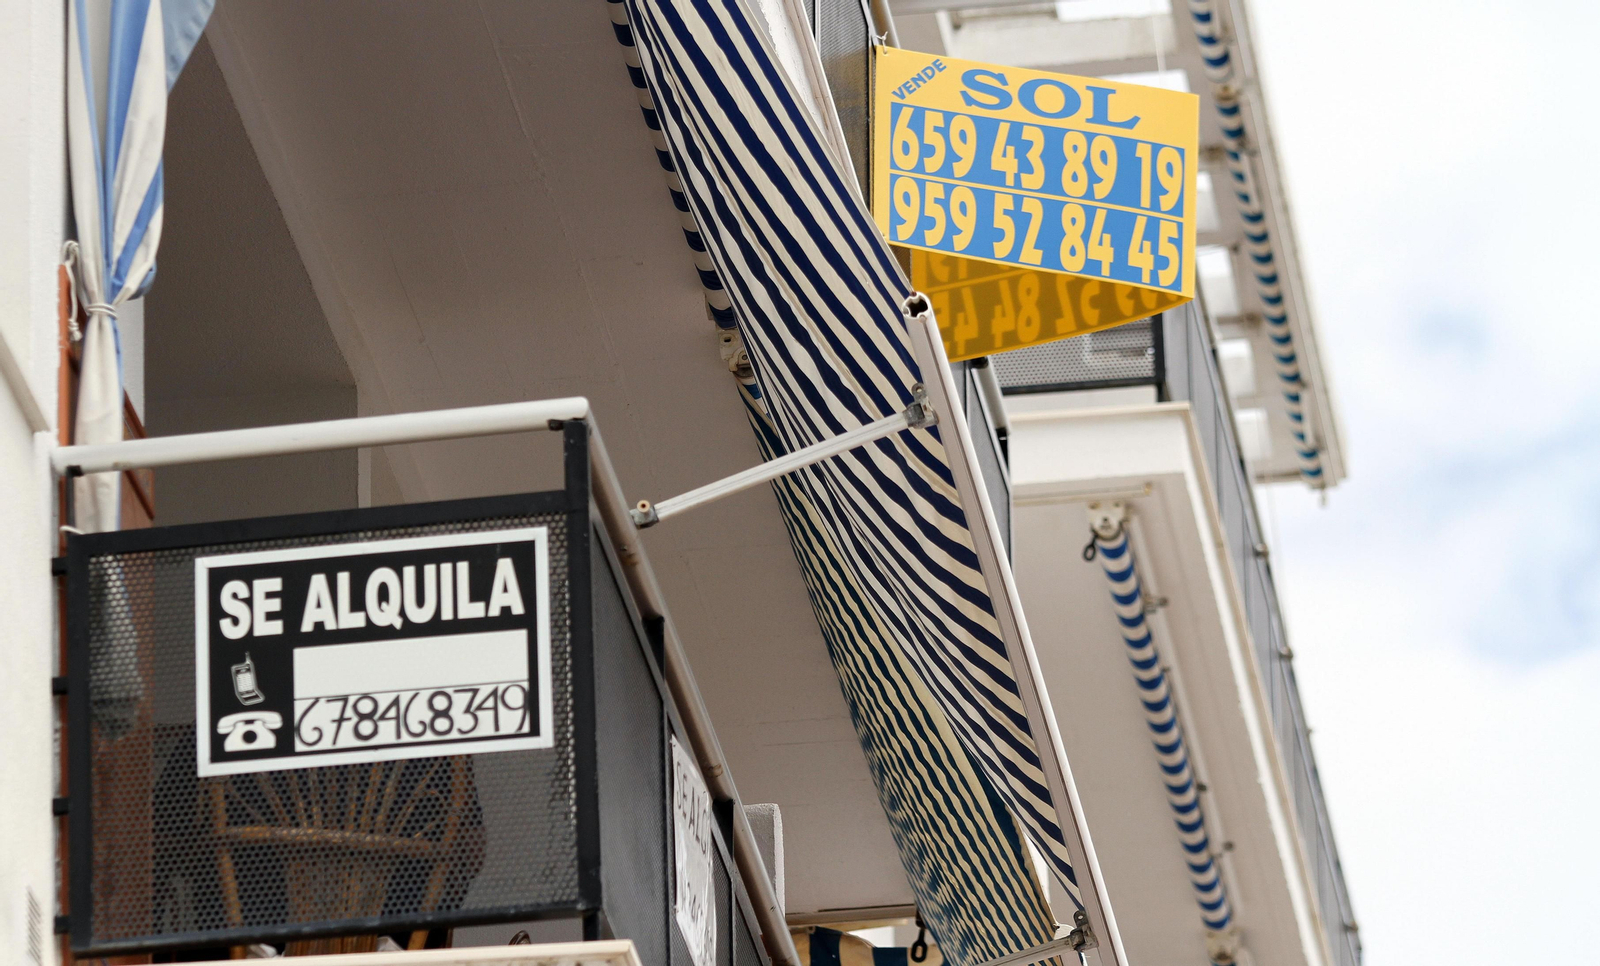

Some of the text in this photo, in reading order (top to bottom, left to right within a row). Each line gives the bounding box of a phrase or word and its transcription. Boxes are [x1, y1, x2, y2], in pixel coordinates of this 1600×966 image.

[891, 59, 947, 100] VENDE
[960, 69, 1141, 130] SOL
[892, 107, 1183, 211] 659 43 89 19
[893, 176, 1179, 286] 959 52 84 45
[219, 557, 525, 640] SE ALQUILA
[296, 683, 528, 746] 678468349
